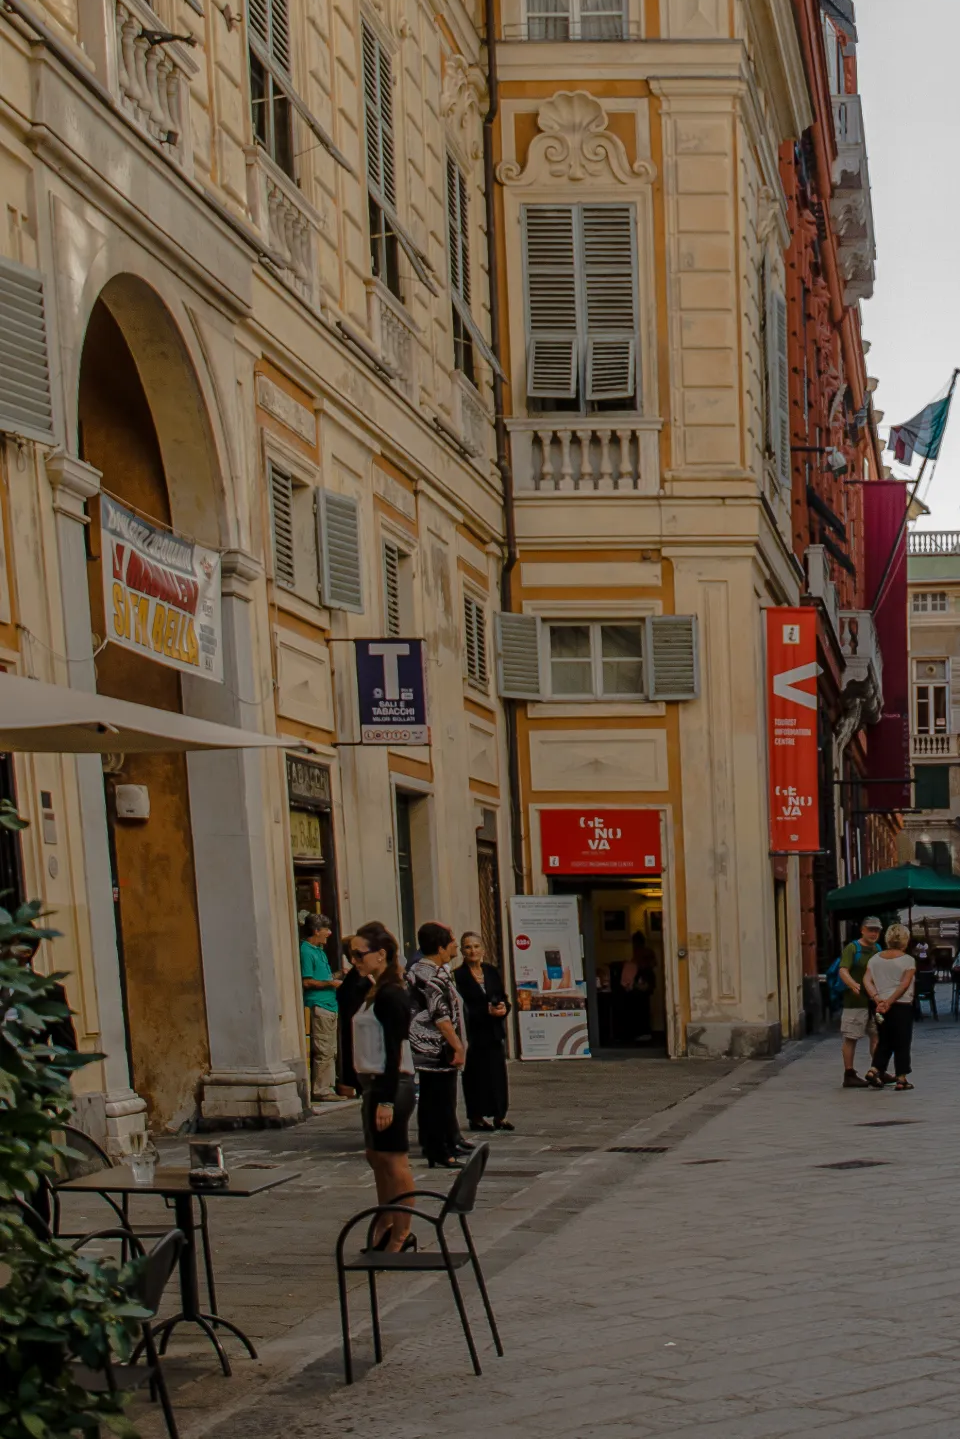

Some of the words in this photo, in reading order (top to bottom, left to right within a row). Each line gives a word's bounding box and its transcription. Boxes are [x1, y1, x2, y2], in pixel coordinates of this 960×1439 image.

[152, 602, 200, 667] BELLA
[368, 643, 410, 700] T
[378, 700, 397, 708] SALI
[399, 700, 406, 708] E
[371, 707, 415, 716] TABACCHI
[774, 737, 796, 746] CENTRE
[782, 806, 802, 816] VA
[587, 839, 611, 850] VA
